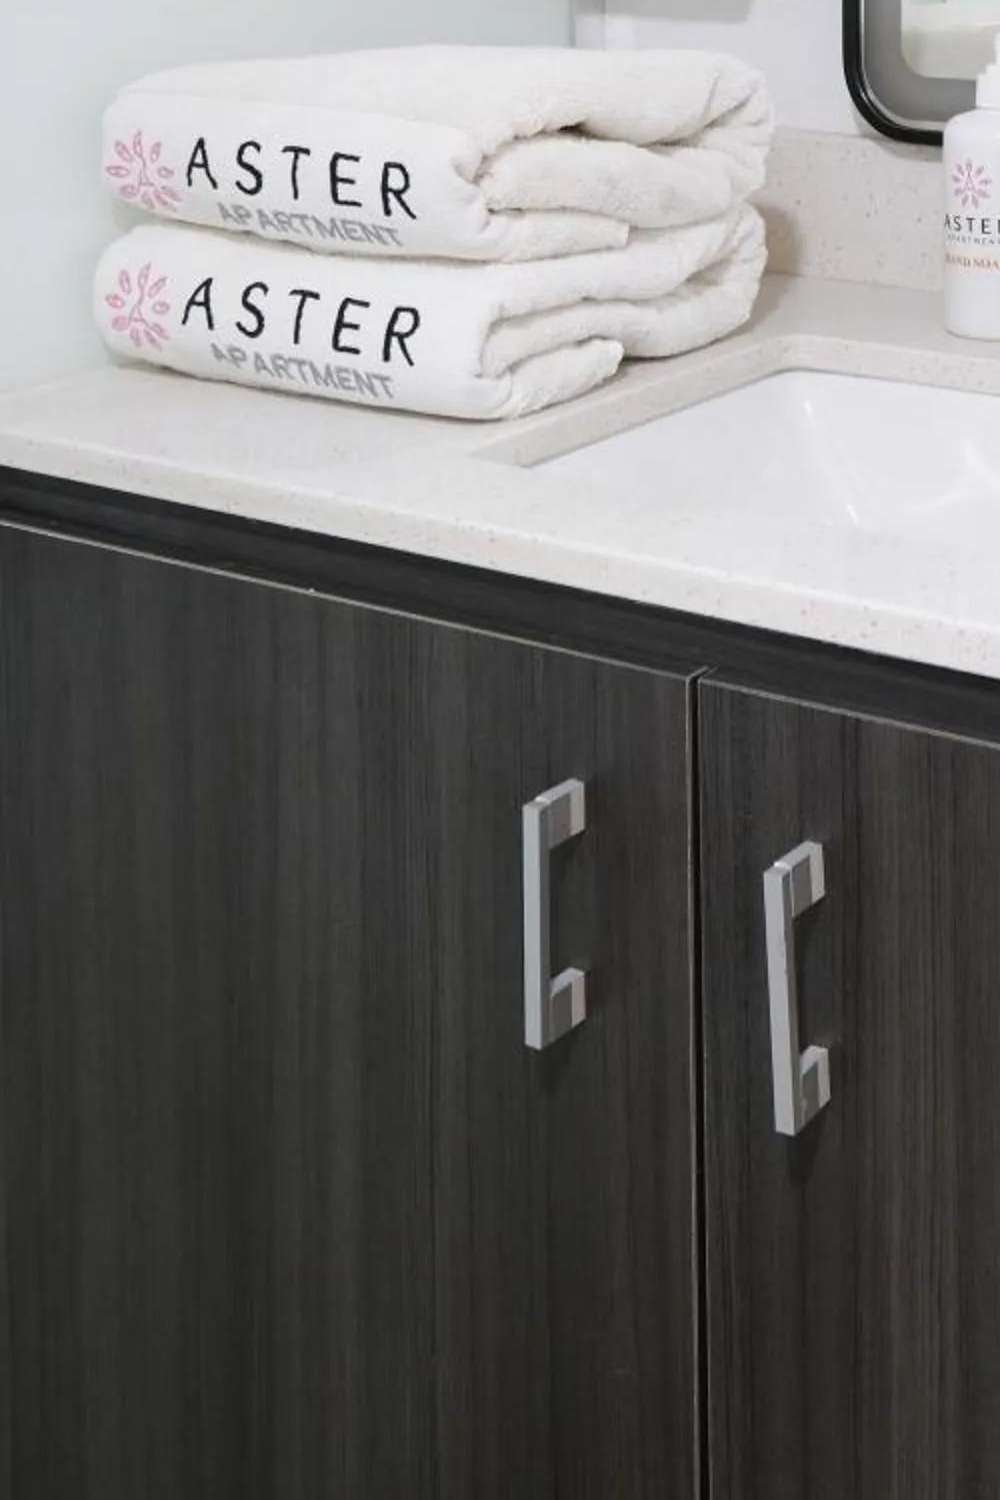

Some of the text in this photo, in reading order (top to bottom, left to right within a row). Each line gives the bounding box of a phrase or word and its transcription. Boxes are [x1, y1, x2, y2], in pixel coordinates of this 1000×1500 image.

[185, 136, 418, 220] ASTER
[216, 201, 404, 248] APARTMENT
[181, 276, 421, 367] ASTER
[209, 342, 395, 399] APARTMENT
